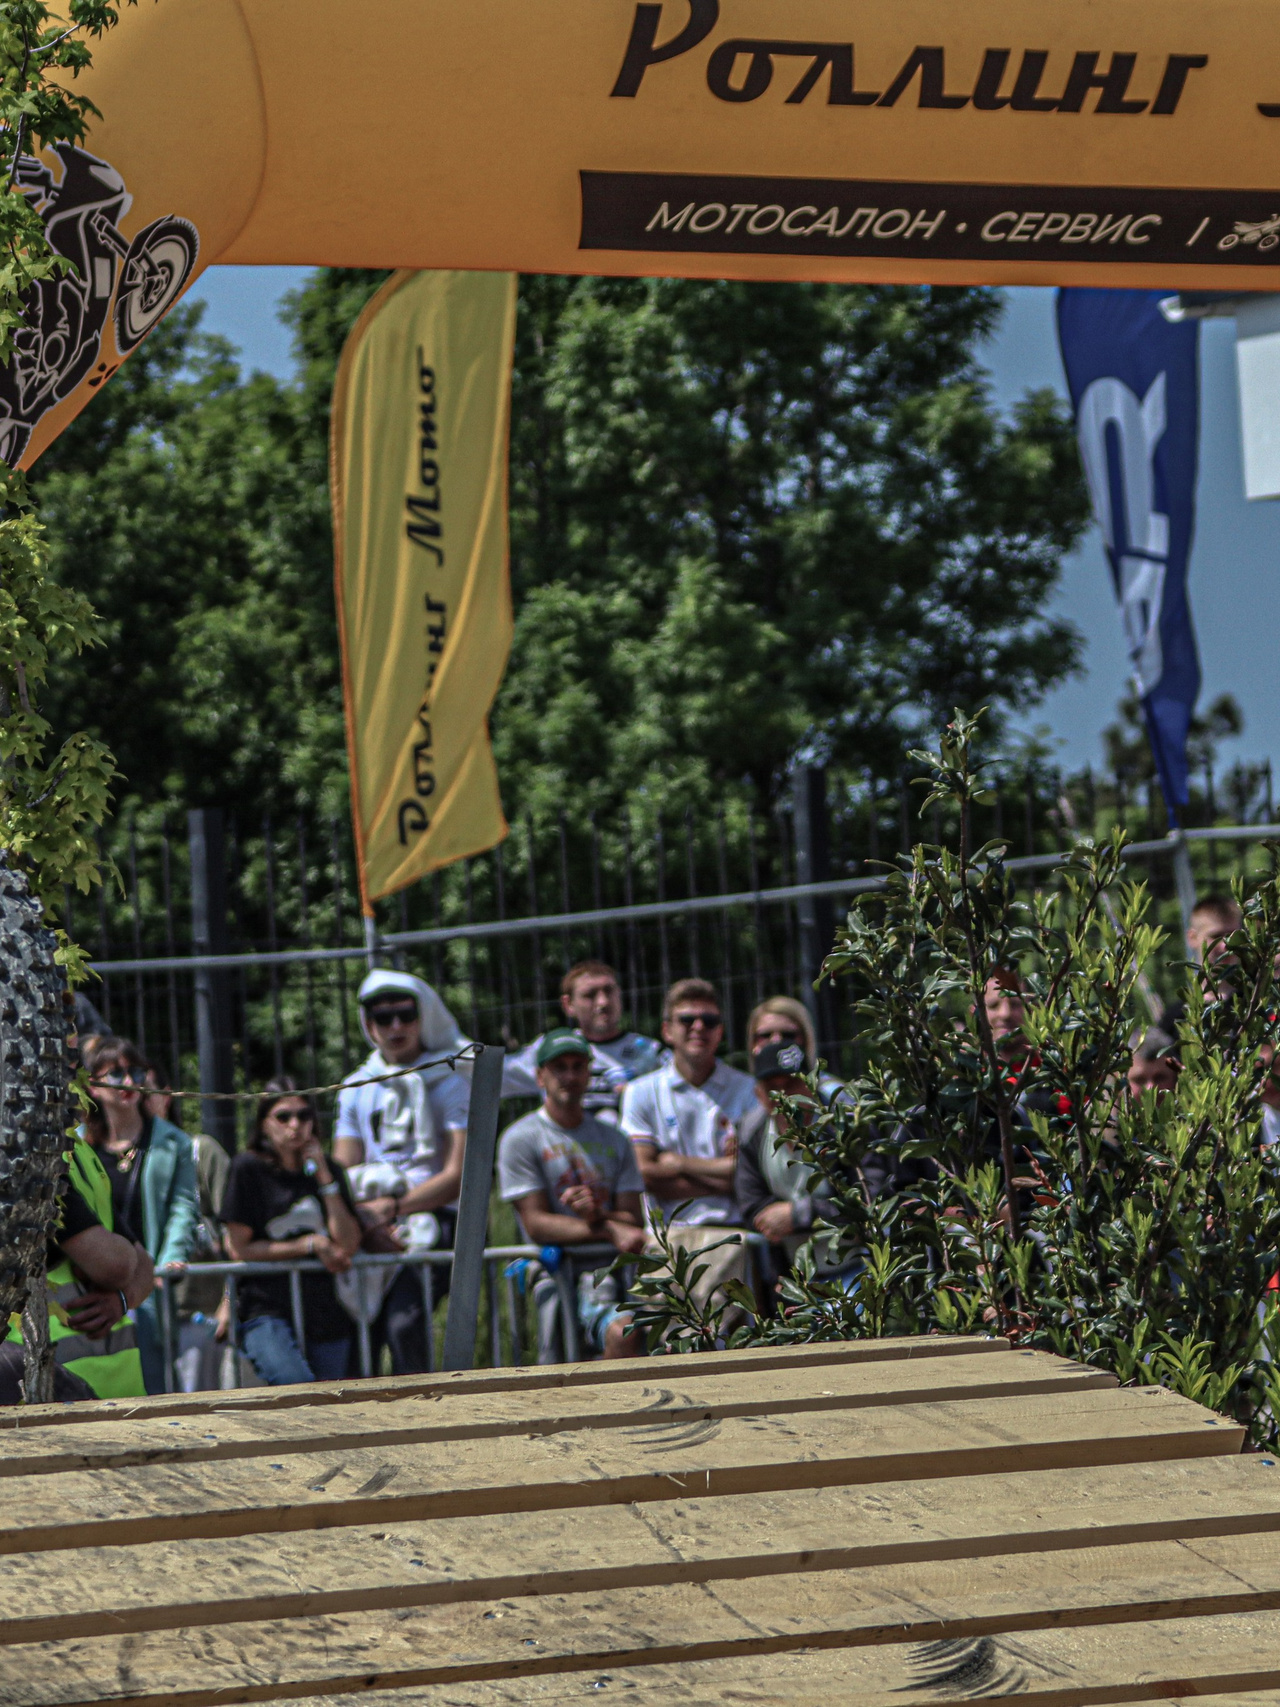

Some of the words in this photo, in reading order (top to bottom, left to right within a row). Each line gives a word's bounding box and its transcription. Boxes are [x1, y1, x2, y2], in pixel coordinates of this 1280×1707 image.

[609, 0, 1209, 116] Роллинг
[645, 201, 948, 242] МОТОСАЛОН
[980, 210, 1163, 246] СЕРВИС
